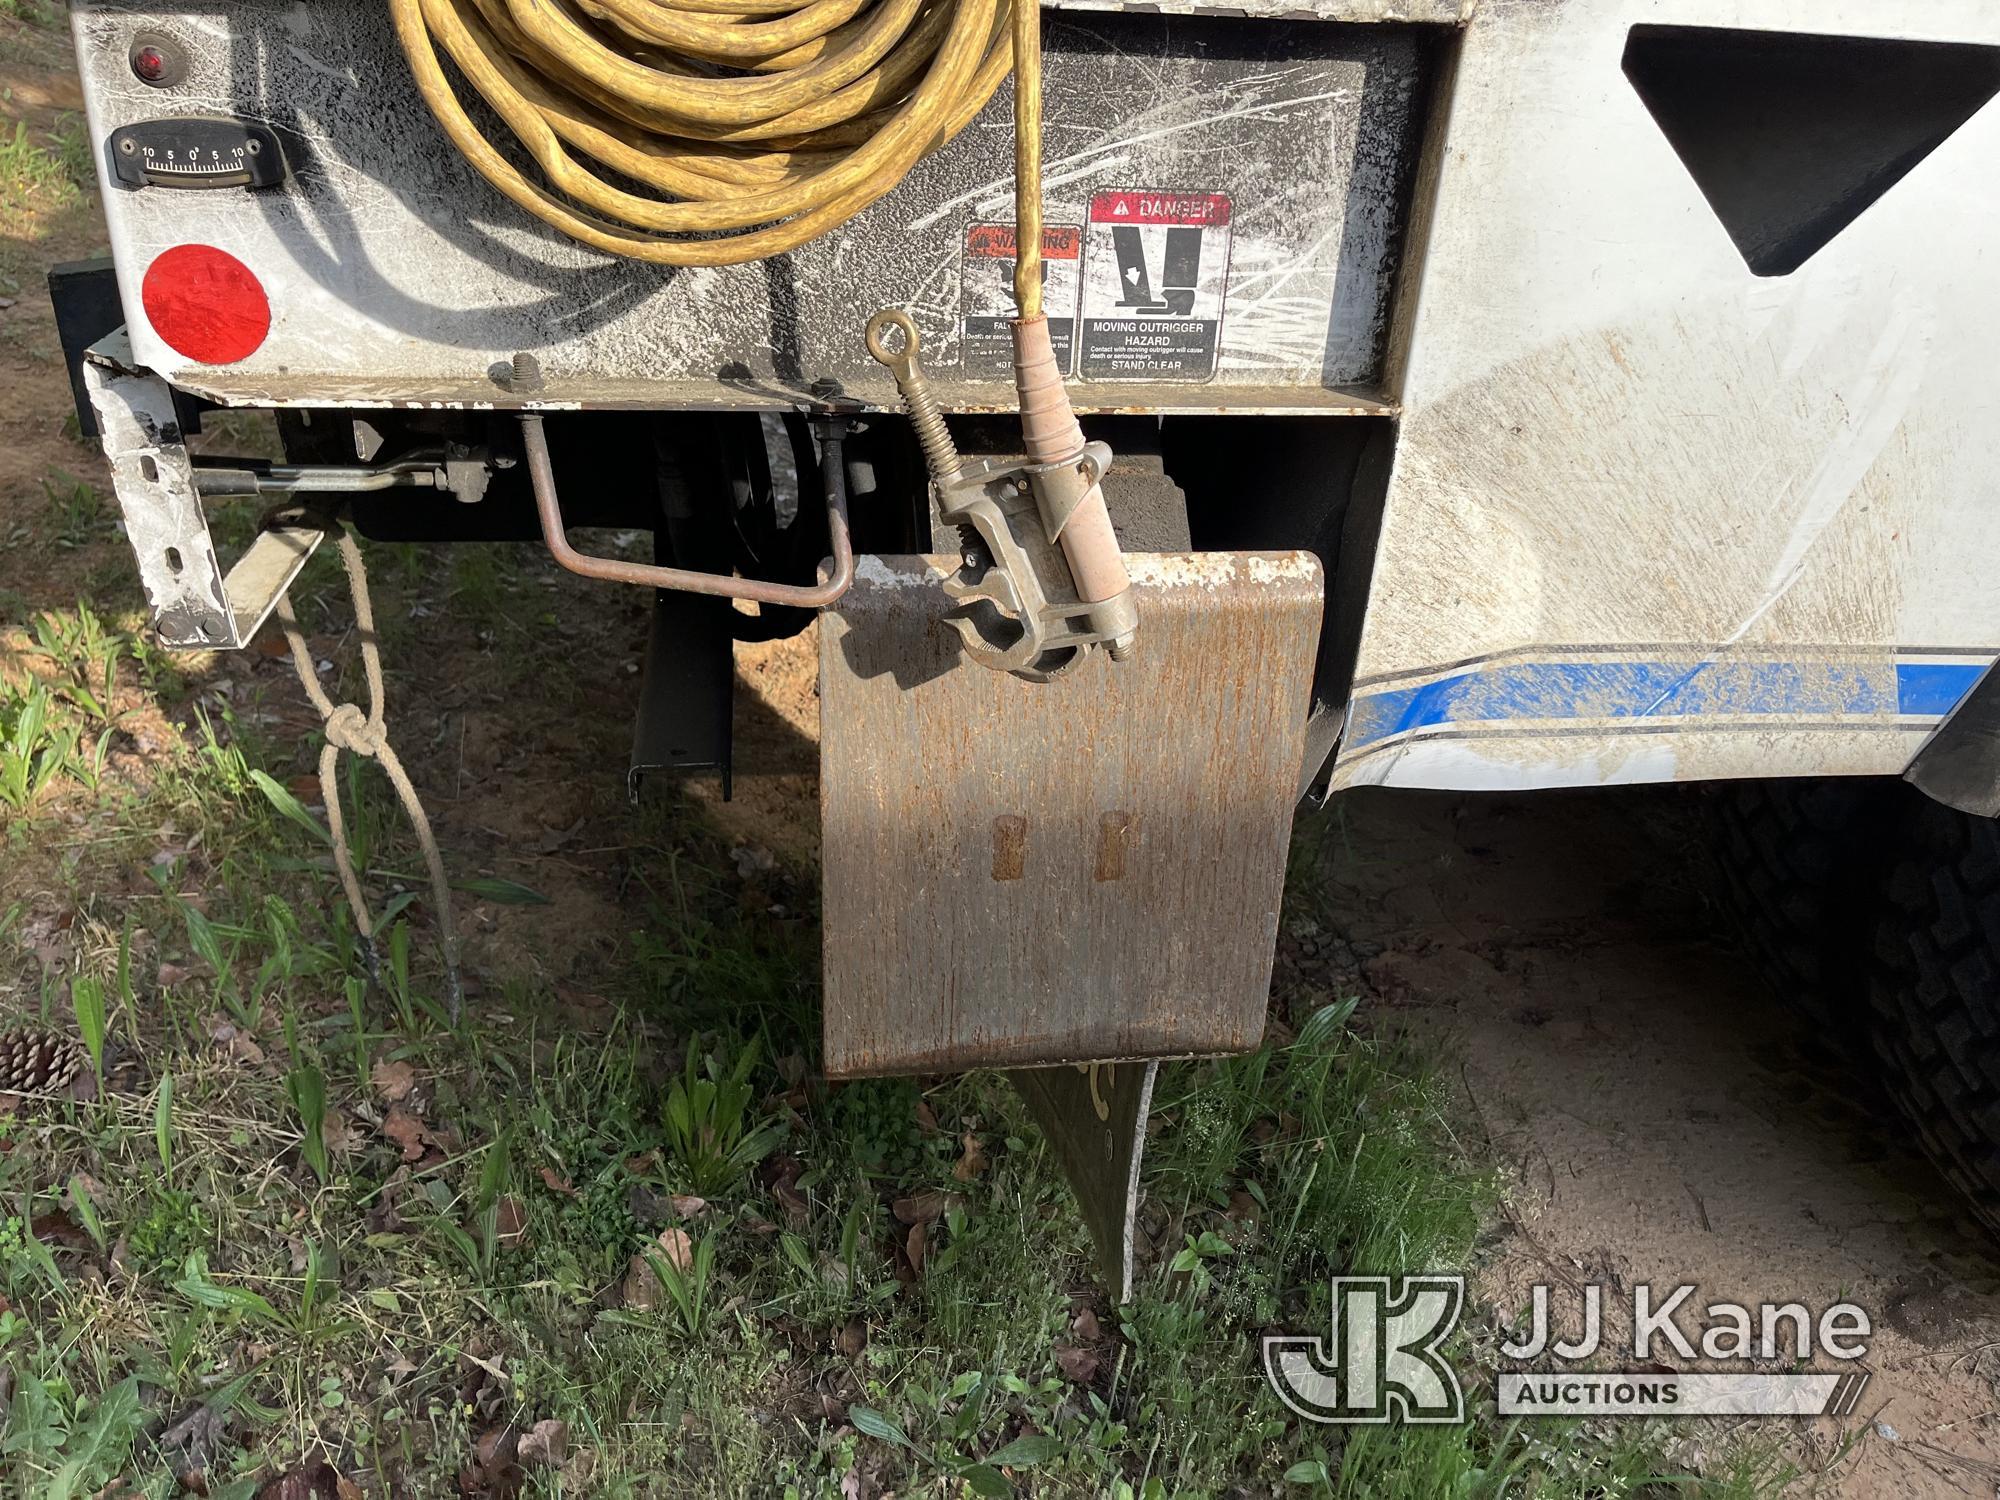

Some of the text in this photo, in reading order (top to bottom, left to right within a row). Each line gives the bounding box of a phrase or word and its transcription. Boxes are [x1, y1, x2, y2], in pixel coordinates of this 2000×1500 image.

[142, 147, 155, 157] 10
[167, 151, 175, 160] 5
[212, 151, 219, 160] 5
[231, 147, 245, 158] 10
[1139, 199, 1215, 218] DANGER
[996, 234, 1071, 249] WAING
[1093, 322, 1204, 333] MOVING OUTRIGGER
[1125, 335, 1170, 346] HAZARD
[1127, 346, 1148, 354] moving
[1111, 360, 1182, 369] STAND CLEAR
